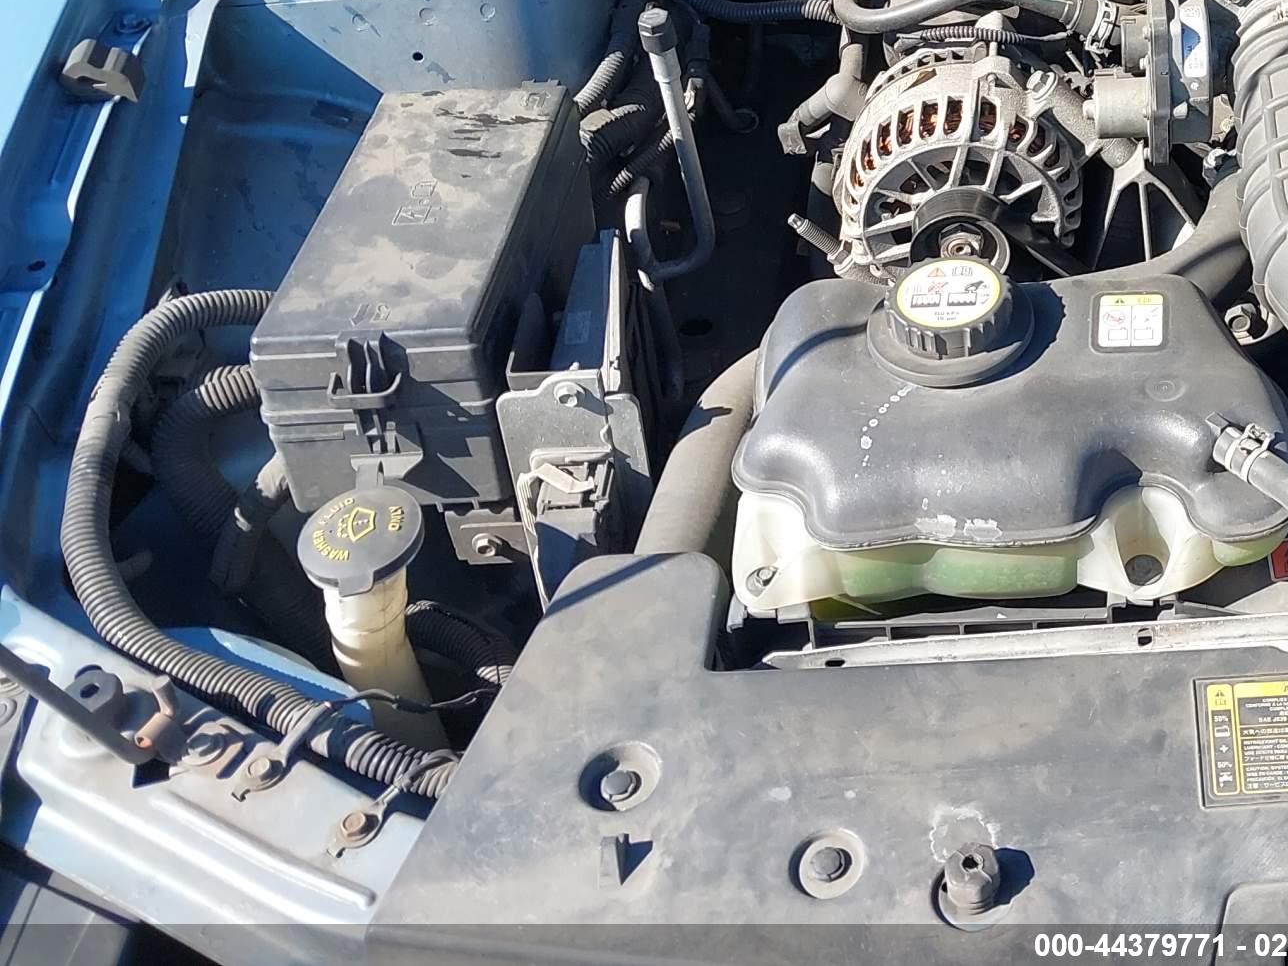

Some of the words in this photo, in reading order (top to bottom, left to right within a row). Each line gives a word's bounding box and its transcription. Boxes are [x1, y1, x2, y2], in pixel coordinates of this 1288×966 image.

[318, 498, 354, 525] FLUID
[388, 506, 404, 531] ONLY
[313, 530, 349, 560] WASHER
